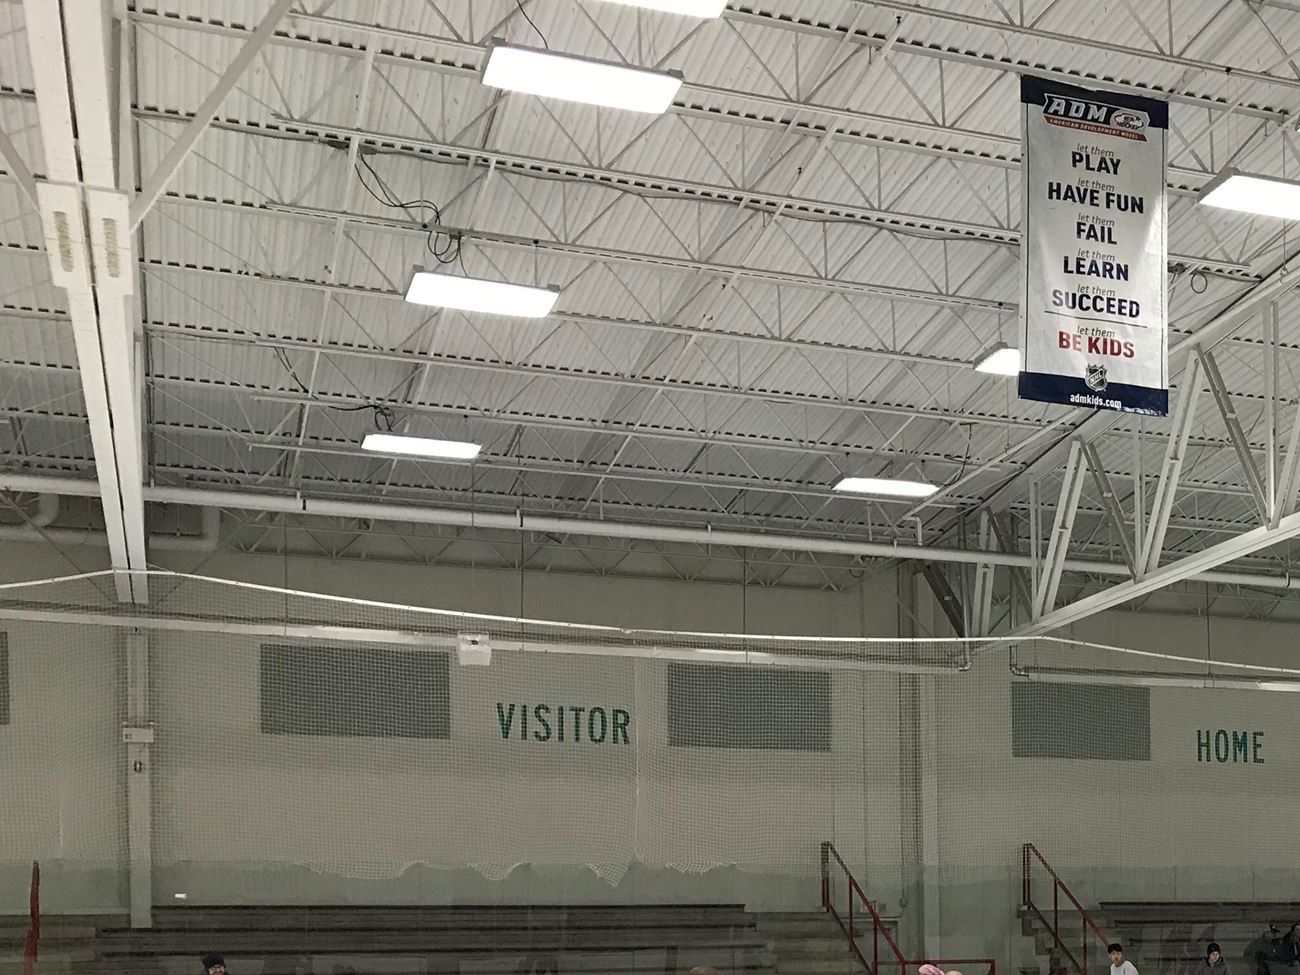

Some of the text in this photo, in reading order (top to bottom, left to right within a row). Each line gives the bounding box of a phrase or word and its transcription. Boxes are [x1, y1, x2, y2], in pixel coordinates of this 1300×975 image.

[1047, 97, 1108, 122] ADM
[1077, 143, 1115, 157] let them
[1072, 151, 1121, 175] PLAY
[1077, 178, 1115, 192] let them
[1048, 182, 1144, 214] HAVE FUN
[1078, 213, 1115, 227] let them
[1076, 221, 1117, 245] FAIL
[1078, 248, 1116, 262] let them
[1063, 256, 1129, 281] LEARN
[1077, 284, 1116, 297] let them
[1052, 289, 1140, 318] SUCCEED
[1077, 325, 1116, 338] let them
[1058, 331, 1135, 358] BE KIDS
[1089, 373, 1103, 384] NHL
[1070, 394, 1122, 409] admkids.com
[496, 702, 630, 744] VISITOR
[1196, 729, 1264, 763] HOME
